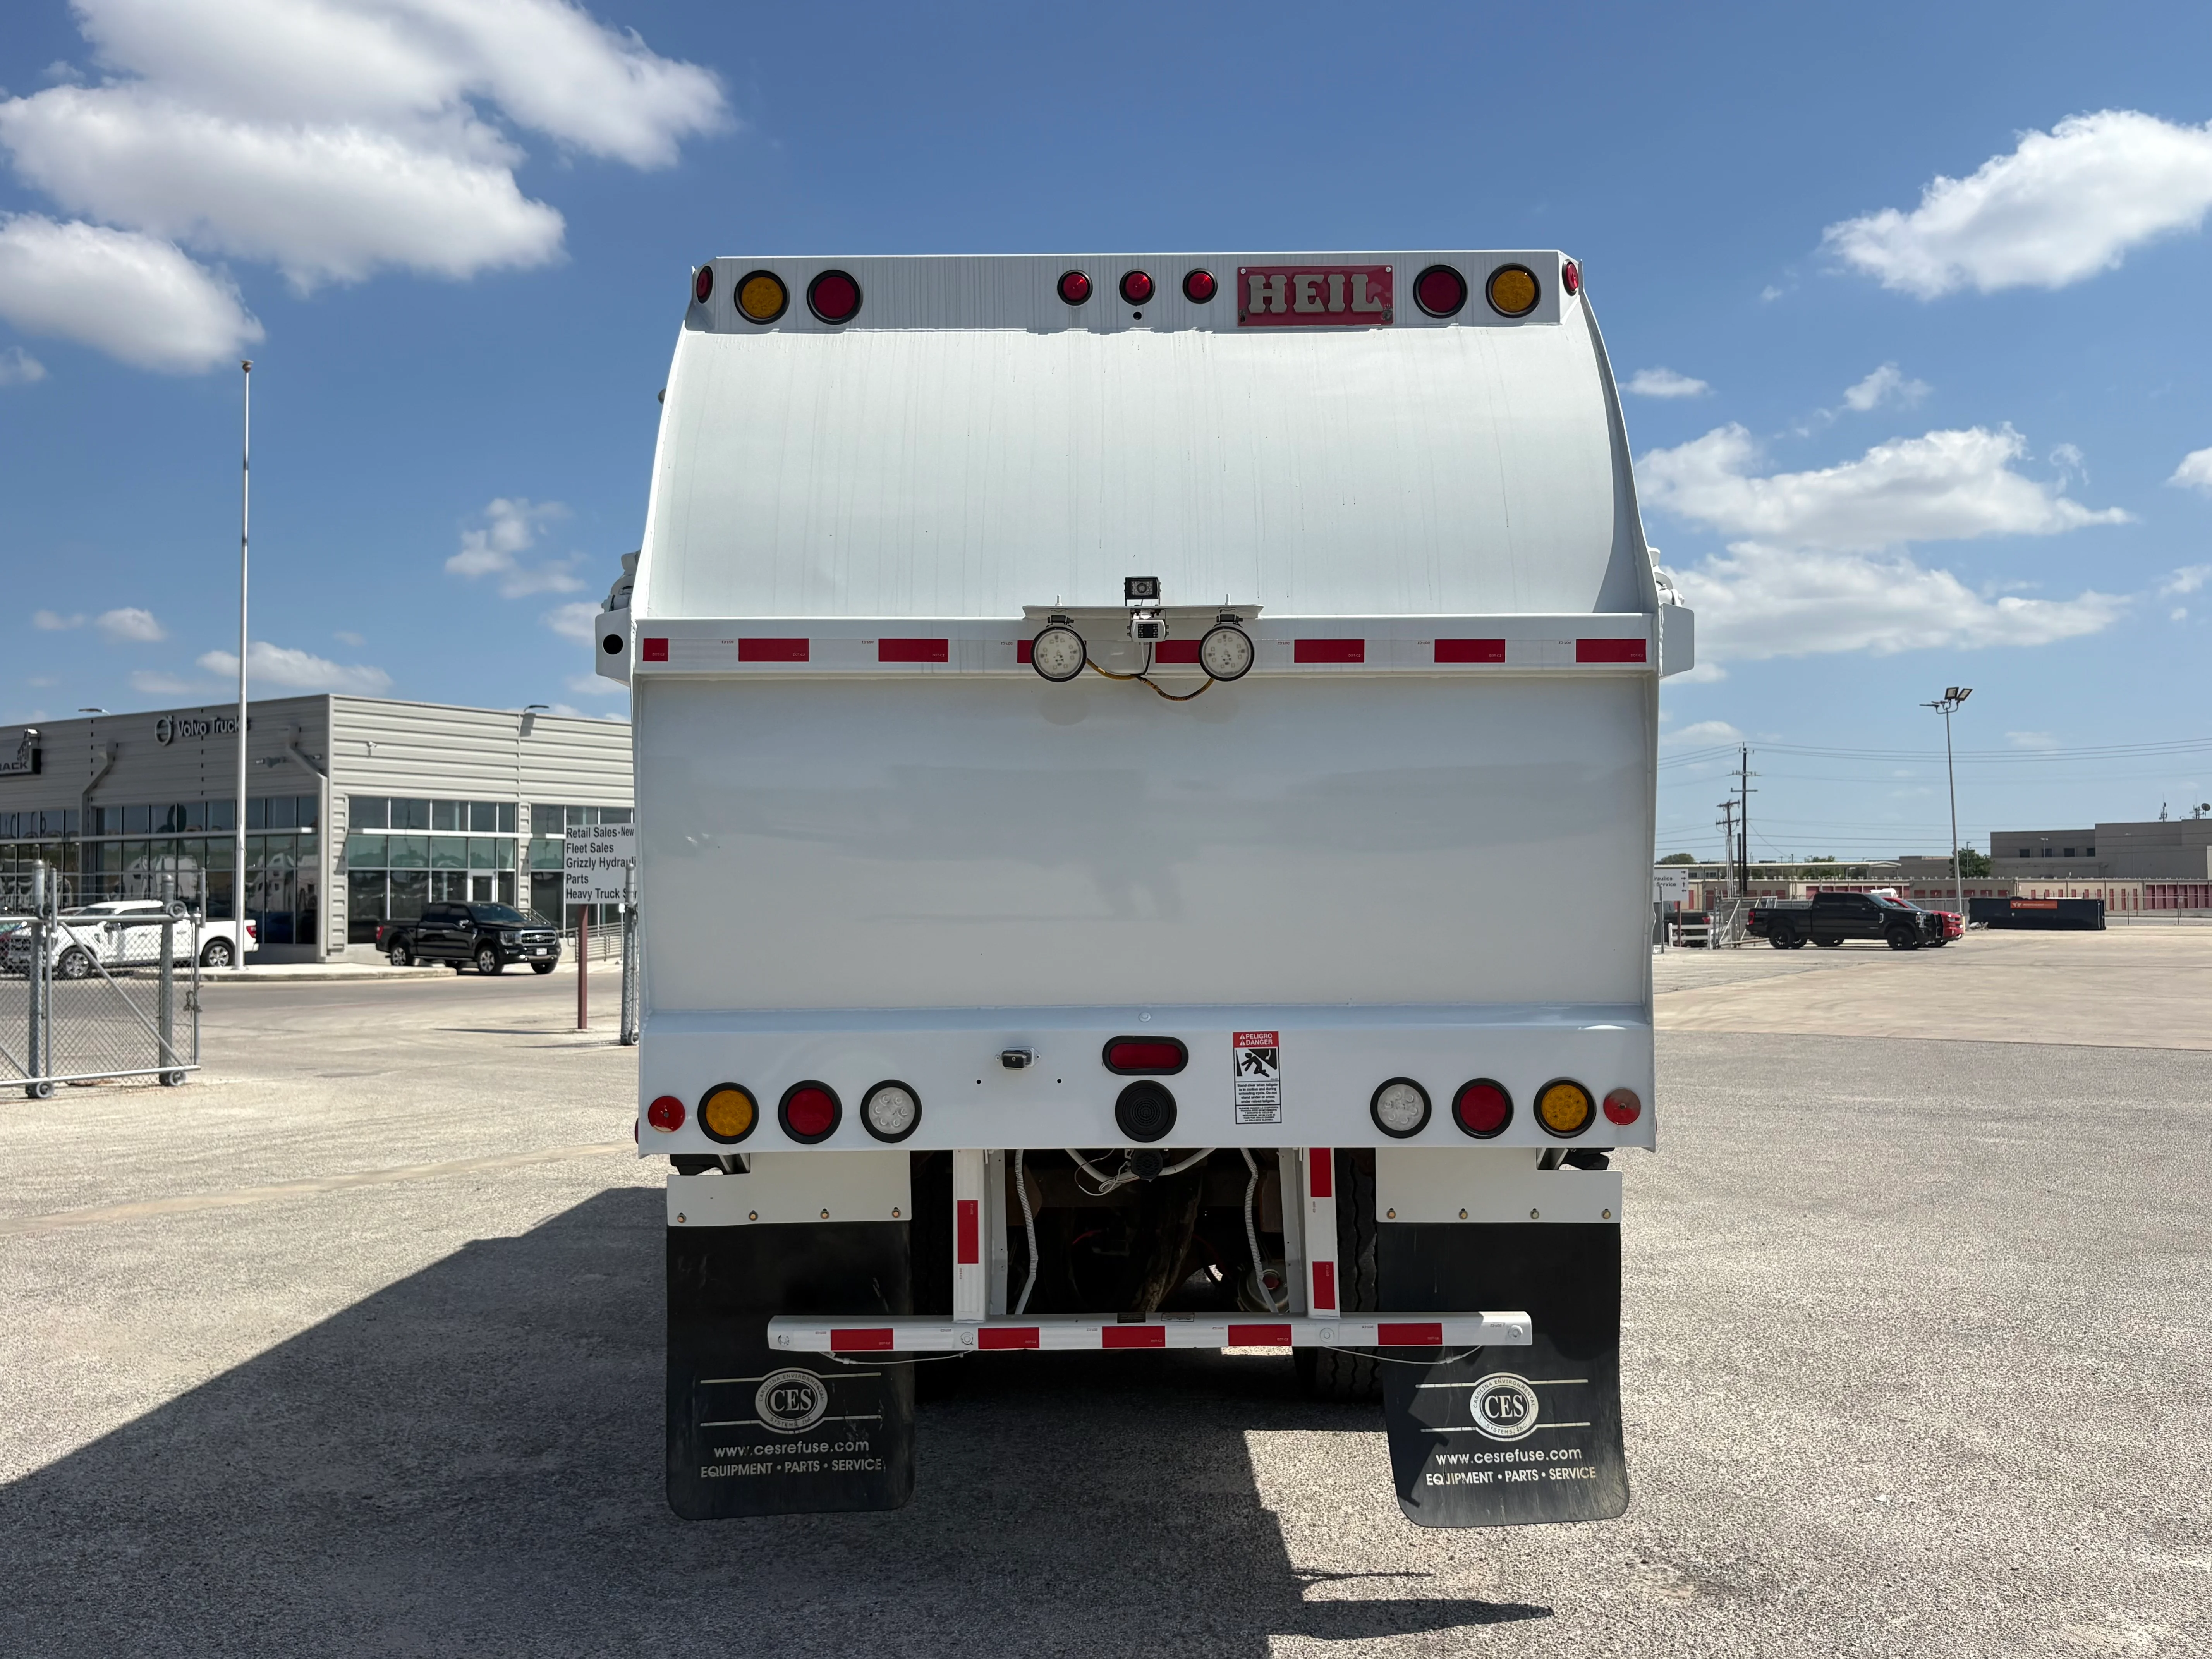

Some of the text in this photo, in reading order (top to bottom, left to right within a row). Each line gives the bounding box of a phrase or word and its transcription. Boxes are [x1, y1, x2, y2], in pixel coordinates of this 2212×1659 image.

[1248, 275, 1383, 313] HEIL
[177, 719, 207, 737] Volvo
[0, 761, 28, 771] ACK
[567, 827, 591, 838] Retail
[566, 842, 614, 854] Fleet Sales
[566, 857, 596, 871] Grizzly
[566, 873, 589, 884] Parts
[566, 888, 592, 902] Heavy
[595, 888, 620, 899] Truck
[758, 1374, 824, 1402] CAROLINA ENVIRONMENTAL
[1473, 1379, 1535, 1408] CAROLINA ENVIRONMENTAL
[770, 1389, 812, 1412] CES
[1485, 1395, 1524, 1418] CES
[714, 1441, 869, 1457] www.cesrefuse.com
[1436, 1448, 1582, 1465] www.cesrefuse.com
[701, 1458, 882, 1478] EQUIPMENT PARTS SERVICE
[1425, 1467, 1596, 1486] EQUIPMENT PARTS SERVICE
